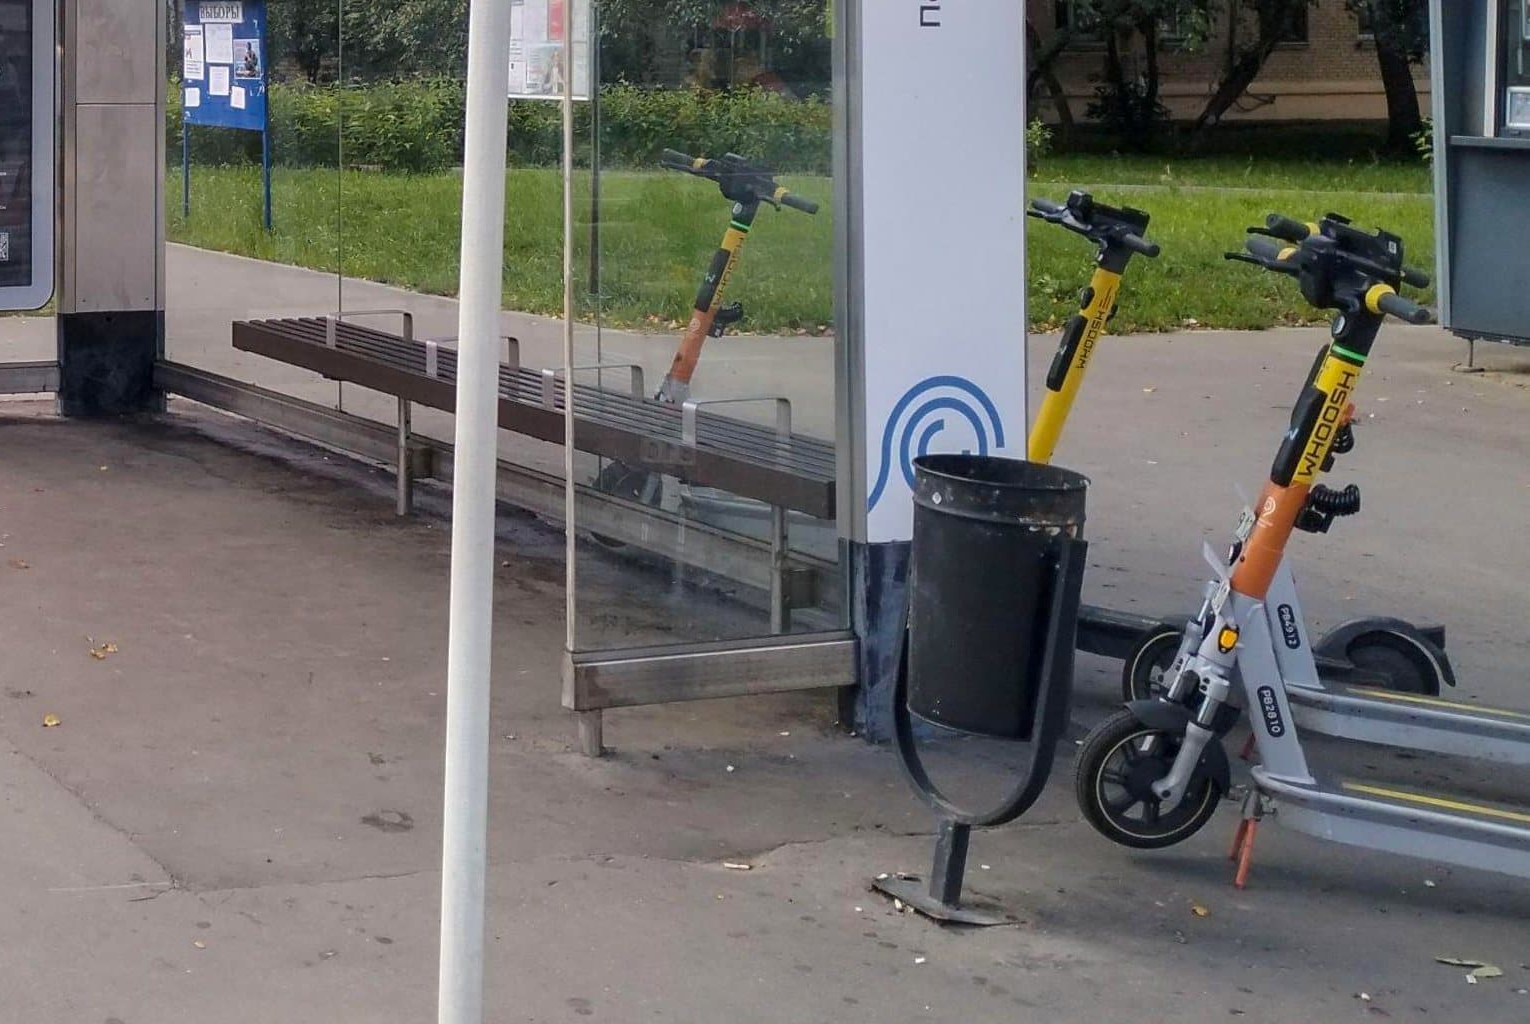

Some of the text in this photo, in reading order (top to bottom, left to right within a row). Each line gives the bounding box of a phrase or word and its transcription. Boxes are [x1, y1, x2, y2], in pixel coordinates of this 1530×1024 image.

[200, 3, 239, 19] ВЫБОРЫ
[1076, 309, 1106, 369] WHOOSH
[1297, 370, 1352, 477] WHOOSH
